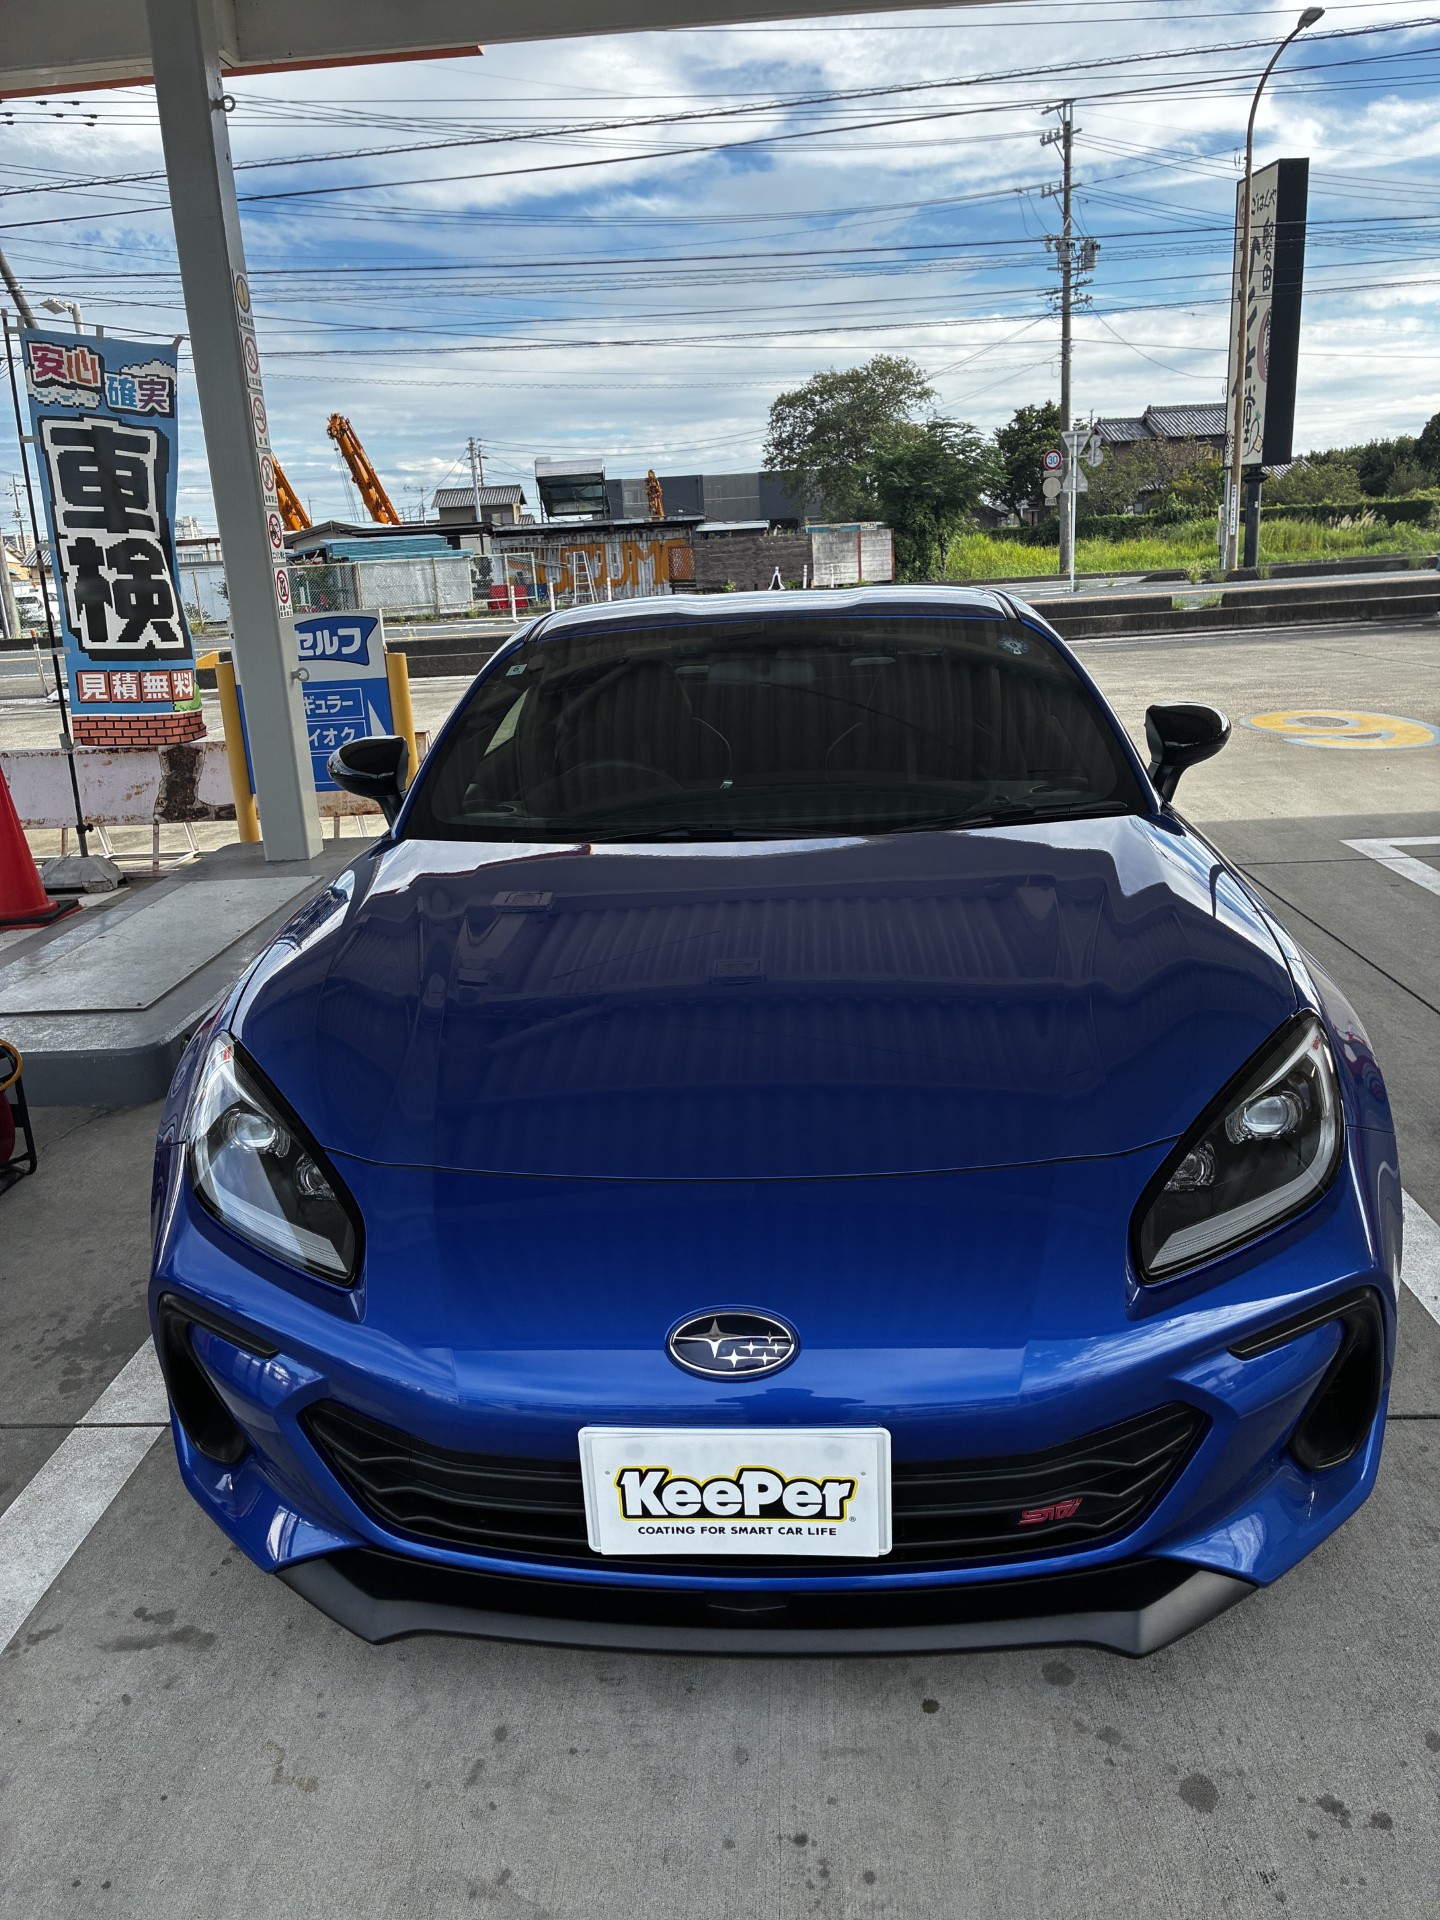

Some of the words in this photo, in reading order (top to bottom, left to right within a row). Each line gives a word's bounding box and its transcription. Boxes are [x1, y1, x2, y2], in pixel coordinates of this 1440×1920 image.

[31, 344, 99, 385] 安心
[106, 374, 168, 412] 確実
[1047, 455, 1059, 465] 30
[47, 422, 180, 645] 車検
[297, 627, 362, 657] セルフ
[81, 671, 194, 700] 見積無料
[616, 1467, 856, 1520] KeePer
[638, 1525, 695, 1536] COATING
[700, 1525, 726, 1536] FOR
[731, 1525, 774, 1536] SMART
[778, 1525, 803, 1536] CAR
[807, 1525, 837, 1536] LIFE
